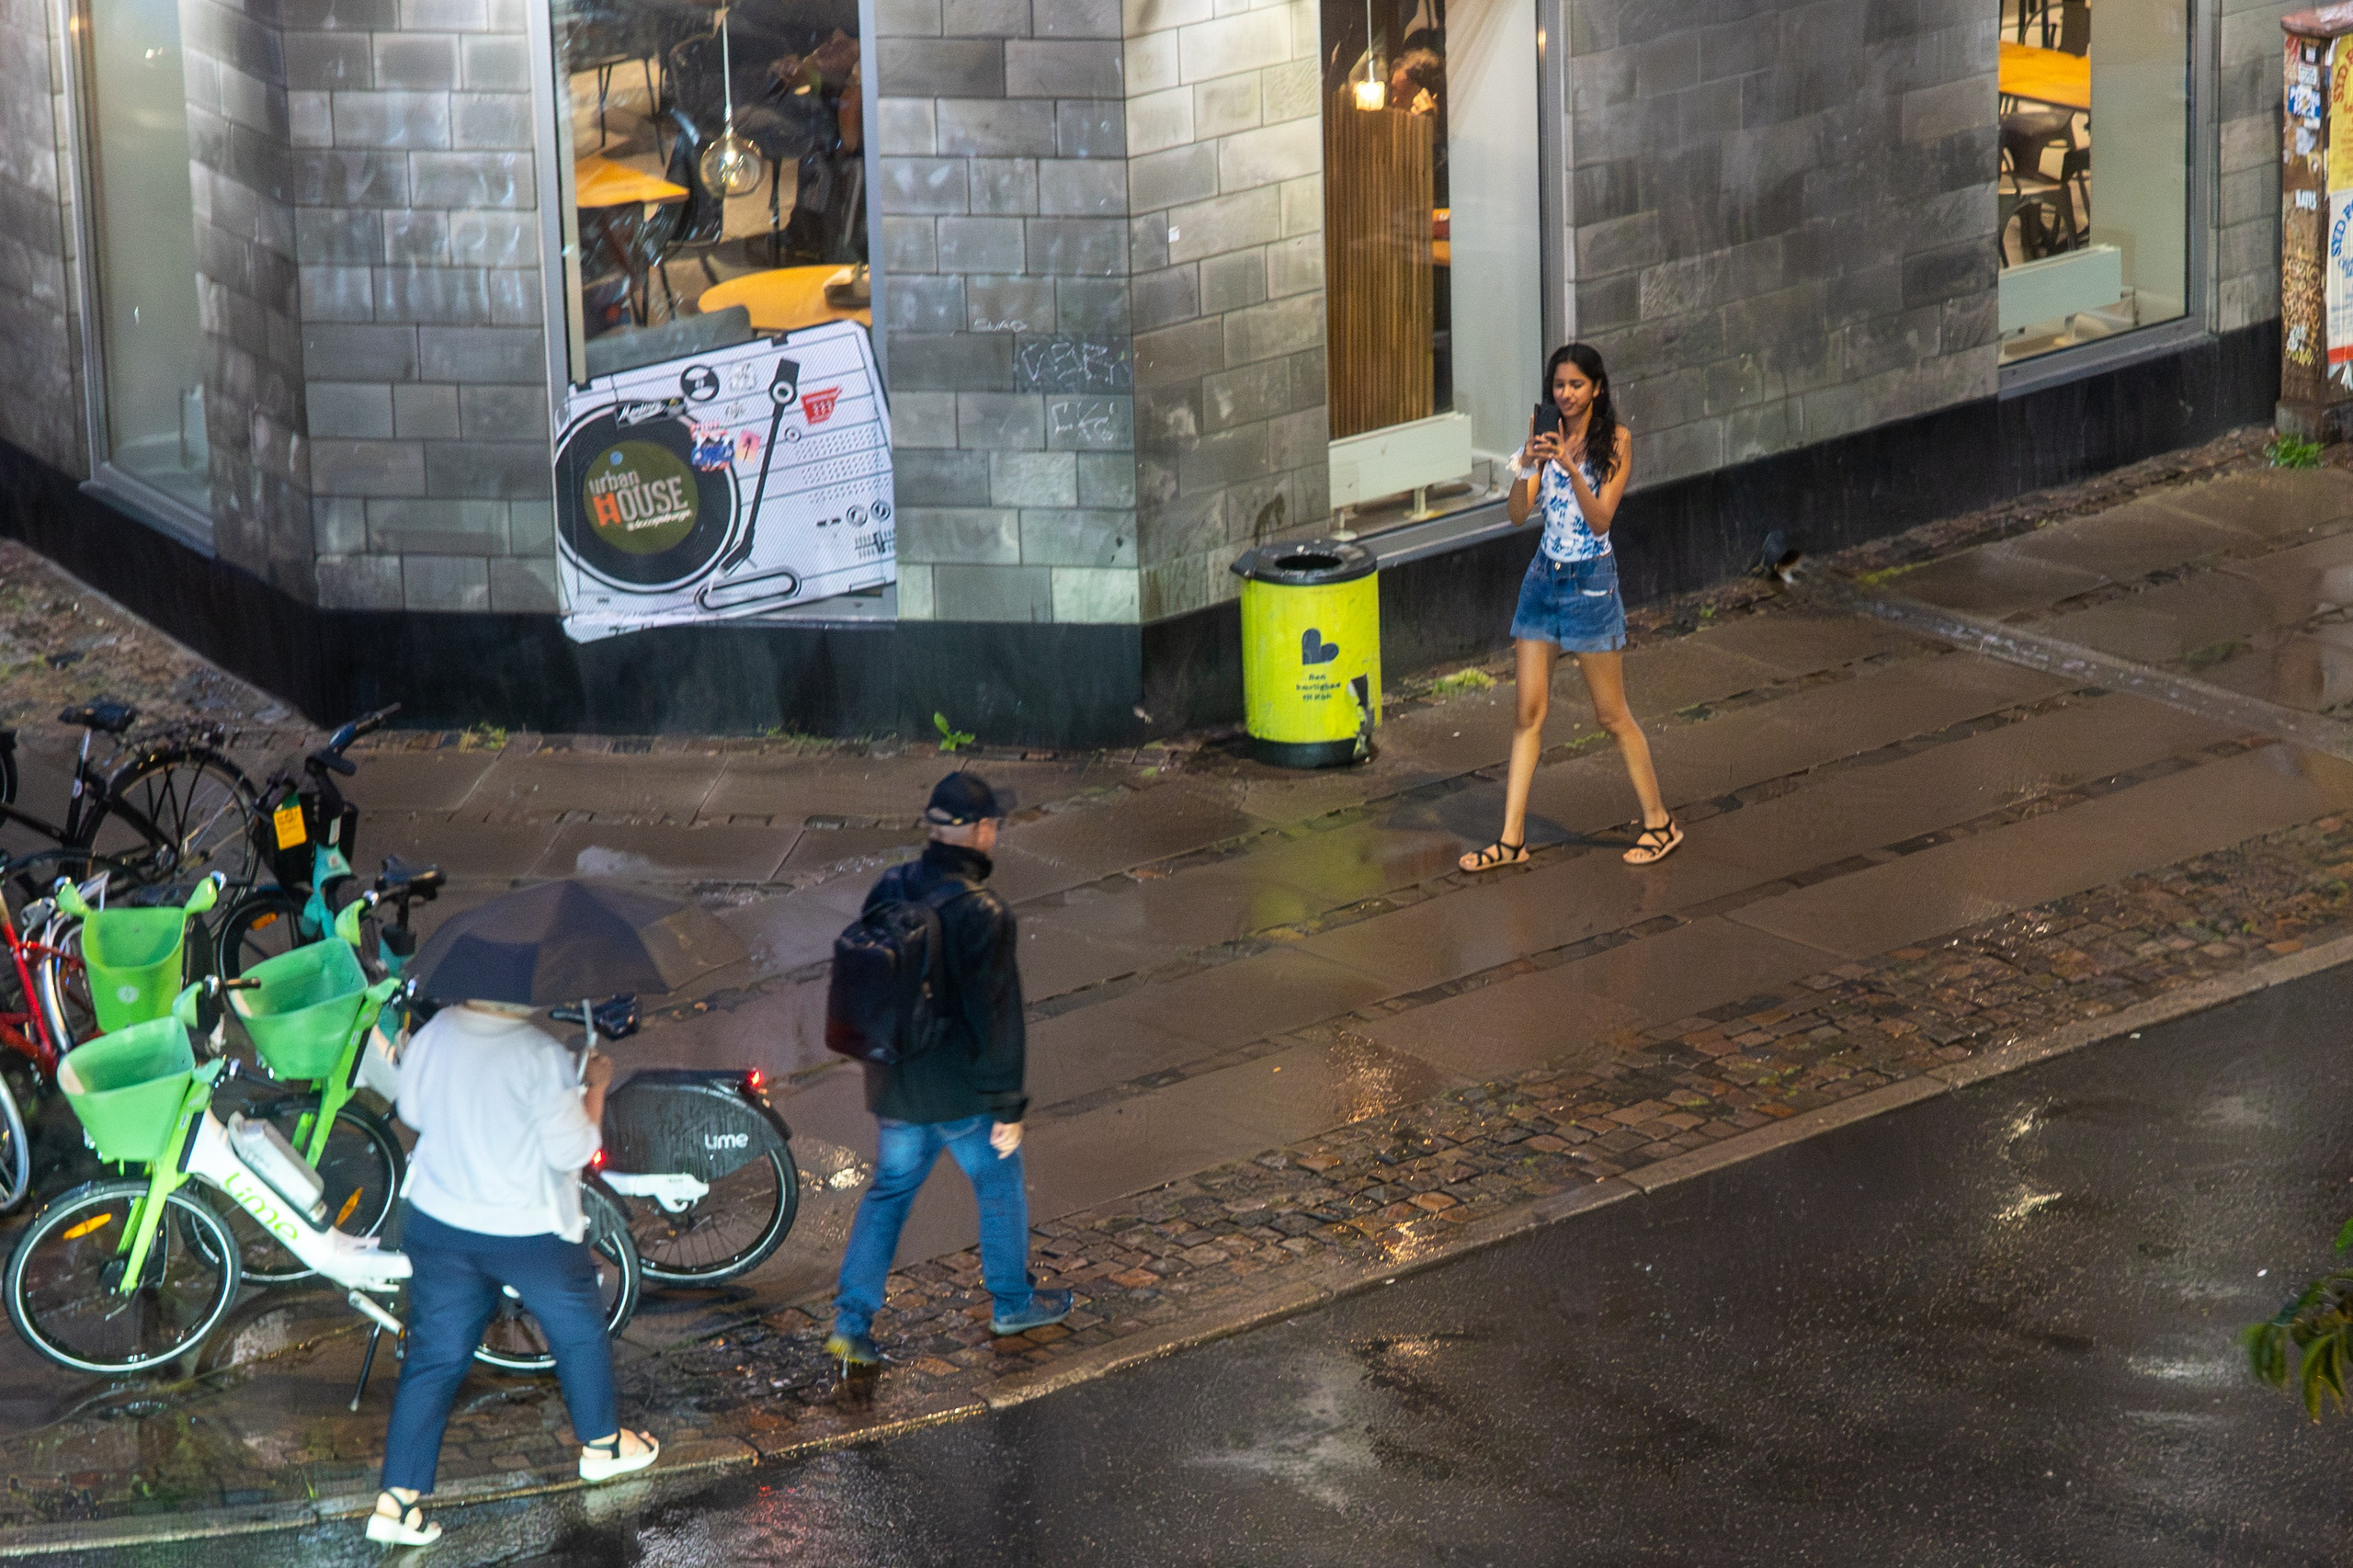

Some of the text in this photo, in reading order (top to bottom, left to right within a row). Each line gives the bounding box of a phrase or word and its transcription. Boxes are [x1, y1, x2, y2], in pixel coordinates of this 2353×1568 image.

[588, 470, 640, 495] urban
[593, 475, 688, 527] HOUSE
[224, 1172, 298, 1240] Lime
